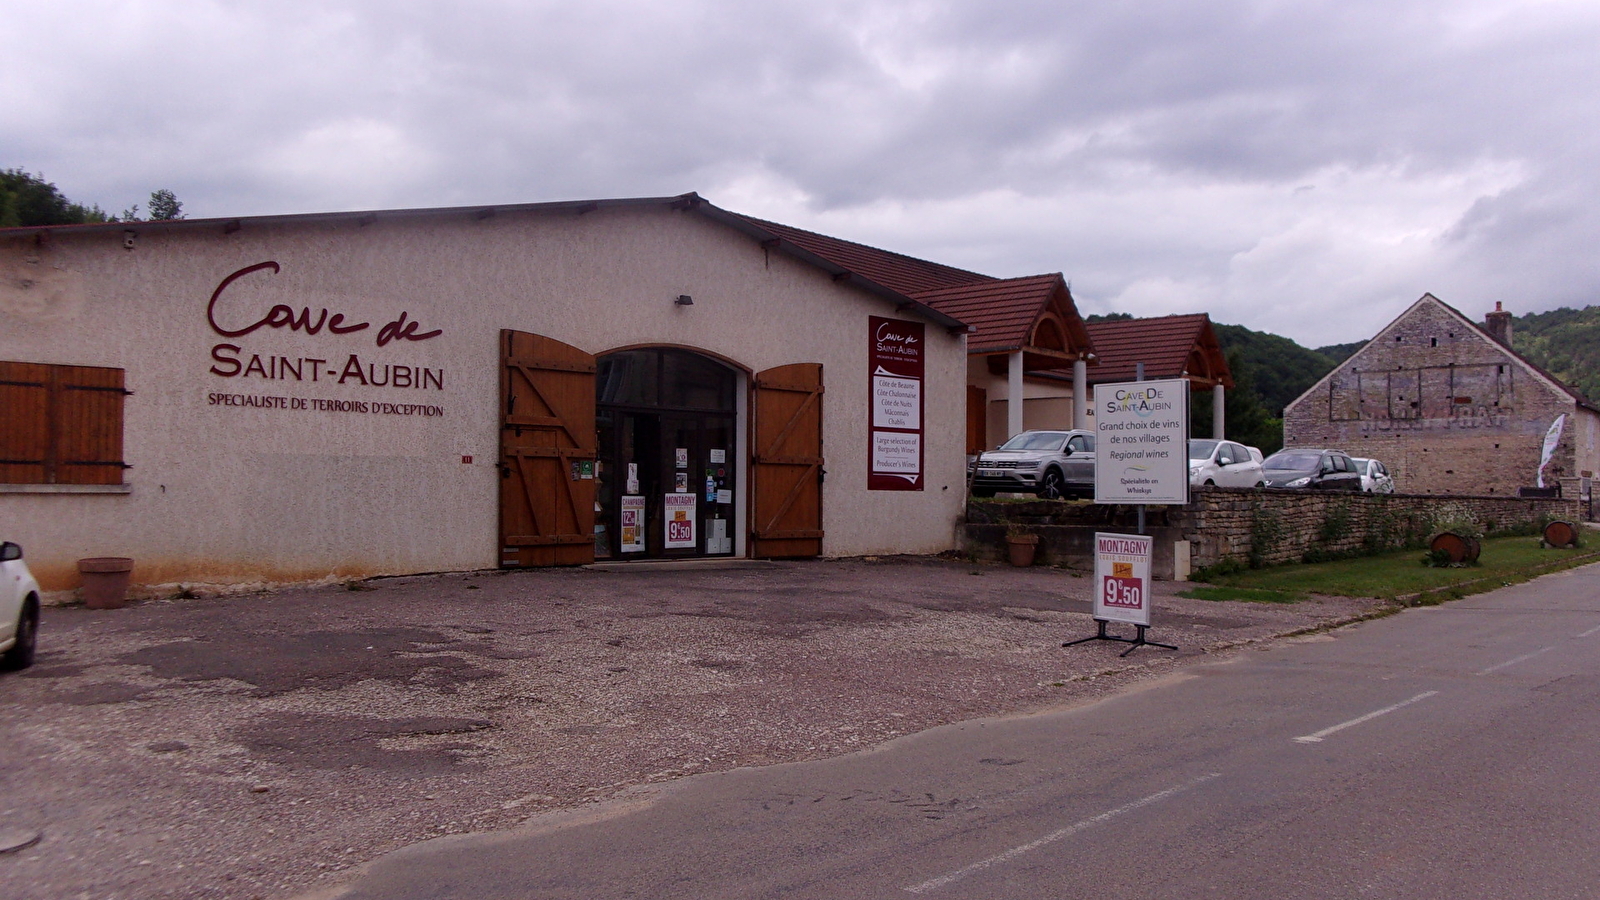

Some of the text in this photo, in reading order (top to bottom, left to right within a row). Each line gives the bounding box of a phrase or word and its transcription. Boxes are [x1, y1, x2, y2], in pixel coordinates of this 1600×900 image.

[207, 261, 443, 347] Cave de
[877, 322, 918, 344] Cave de
[877, 343, 918, 355] SAINT-AUBIN
[209, 343, 444, 390] SAINT-AUBIN
[891, 380, 897, 388] de
[898, 381, 915, 389] Beaune
[889, 390, 917, 399] Chalonnaise
[1115, 389, 1144, 401] CAVE
[208, 392, 444, 417] SPECIALISTE DE TERROIRS D'EXCEPTION
[893, 399, 899, 407] de
[900, 400, 913, 408] Nuits
[1107, 400, 1172, 413] SAINT-AUBIN
[888, 417, 906, 426] Chablis
[1099, 420, 1180, 431] Grand choix de vins
[877, 436, 890, 445] Large
[891, 438, 911, 446] selection
[1110, 434, 1170, 445] de nos villages
[878, 446, 916, 454] Burgundy Wines
[1110, 450, 1169, 461] Regional wines
[902, 461, 916, 469] Wines
[666, 496, 695, 505] MONTAGNY
[1099, 539, 1148, 555] MONTAGNY
